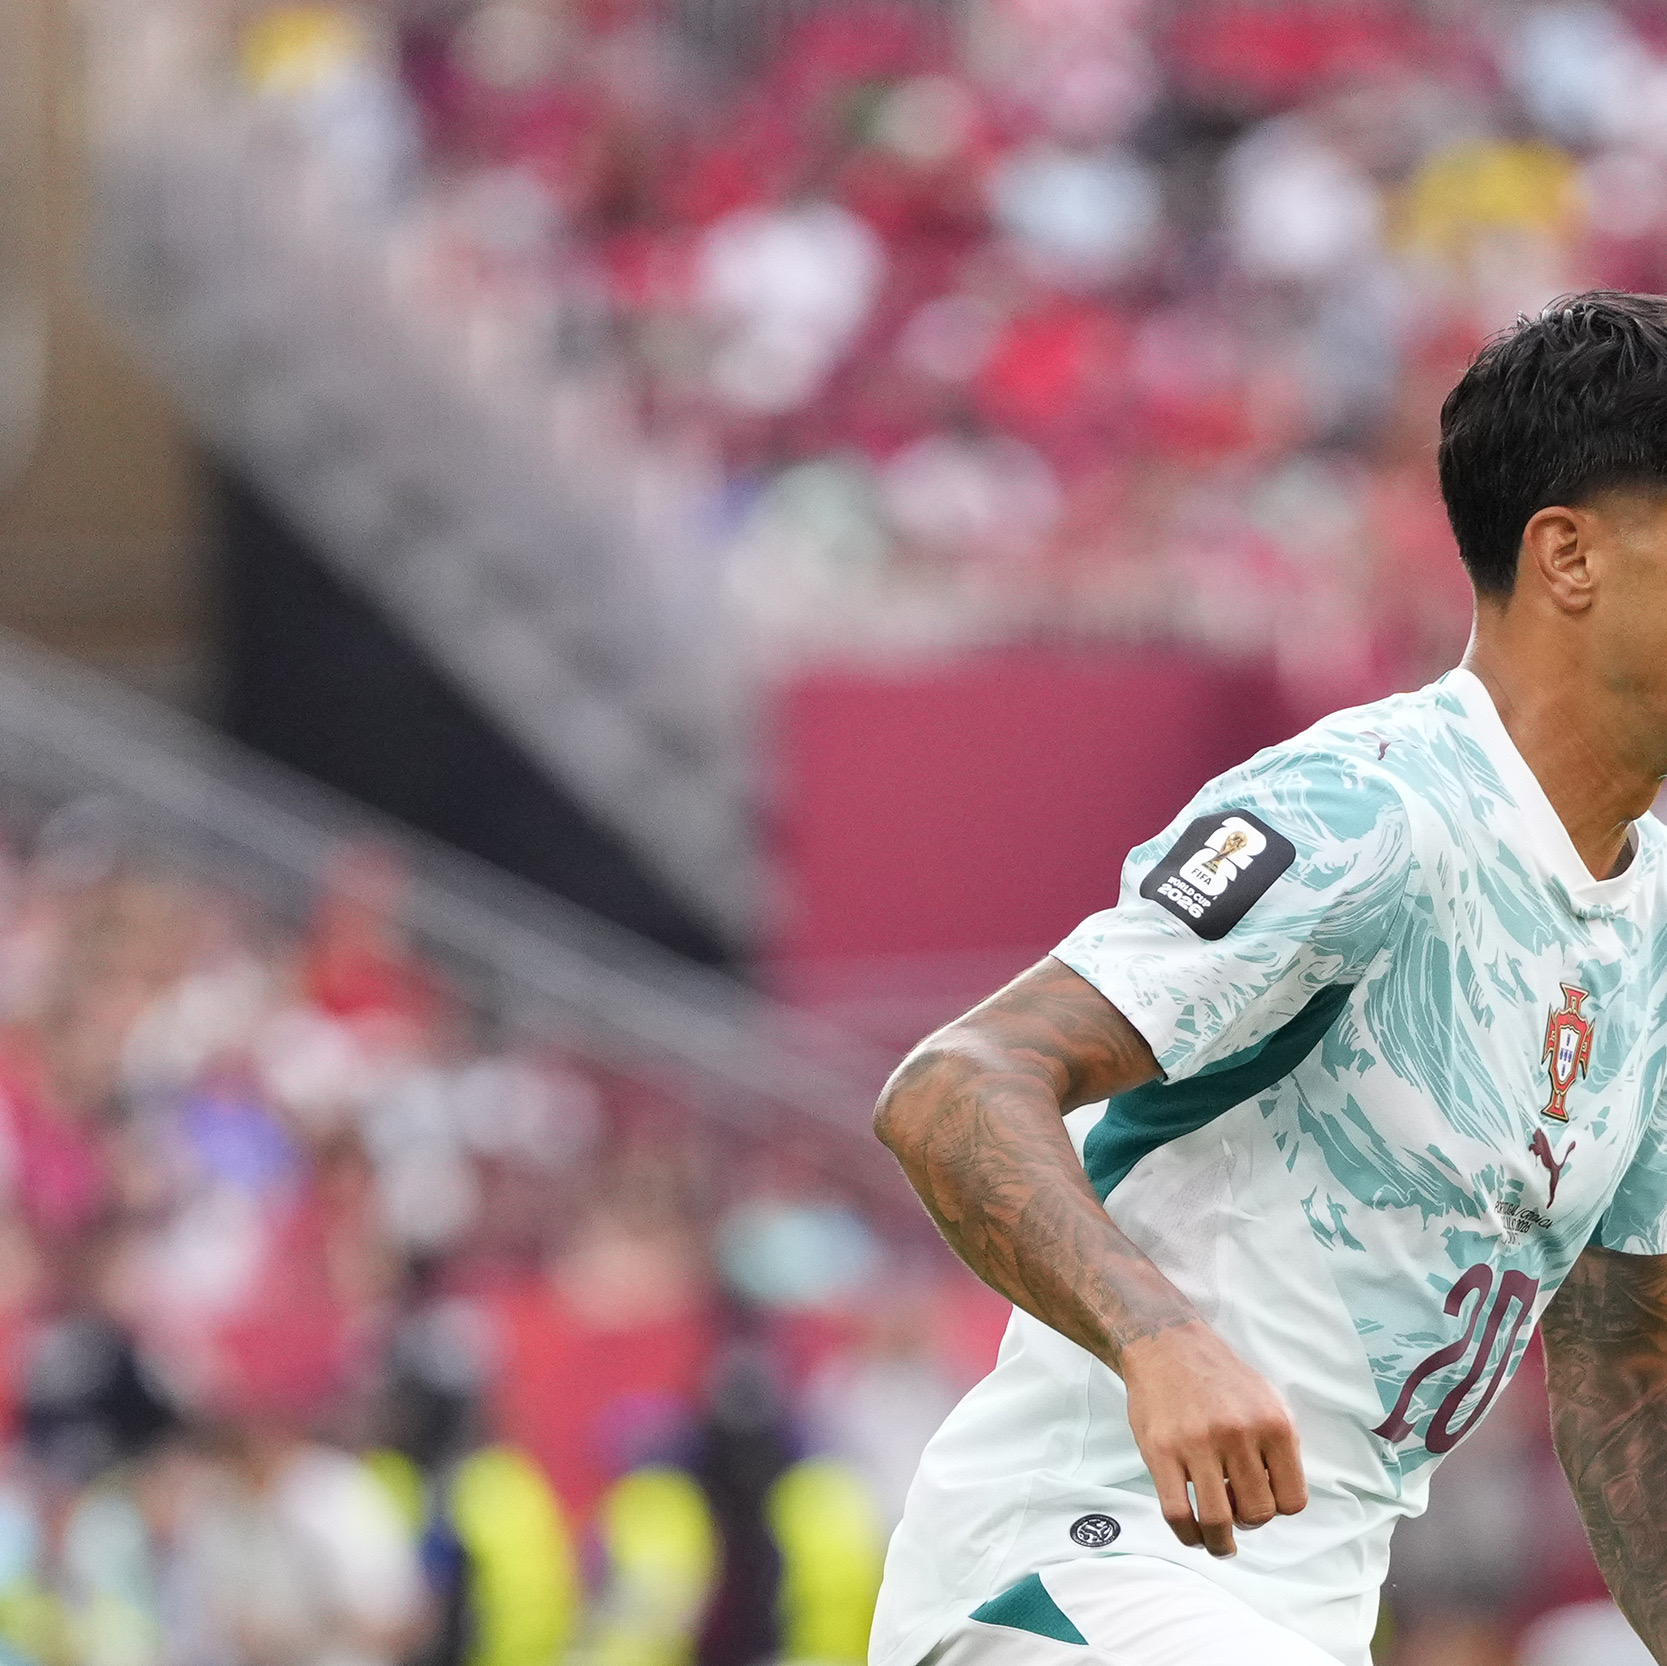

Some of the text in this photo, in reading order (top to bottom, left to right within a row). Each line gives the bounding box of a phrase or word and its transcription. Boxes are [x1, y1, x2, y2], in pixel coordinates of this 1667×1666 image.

[1167, 876, 1212, 908] WORLD CUP
[1191, 868, 1213, 886] FIFA
[1156, 883, 1205, 919] 2026
[1370, 1263, 1540, 1454] 20
